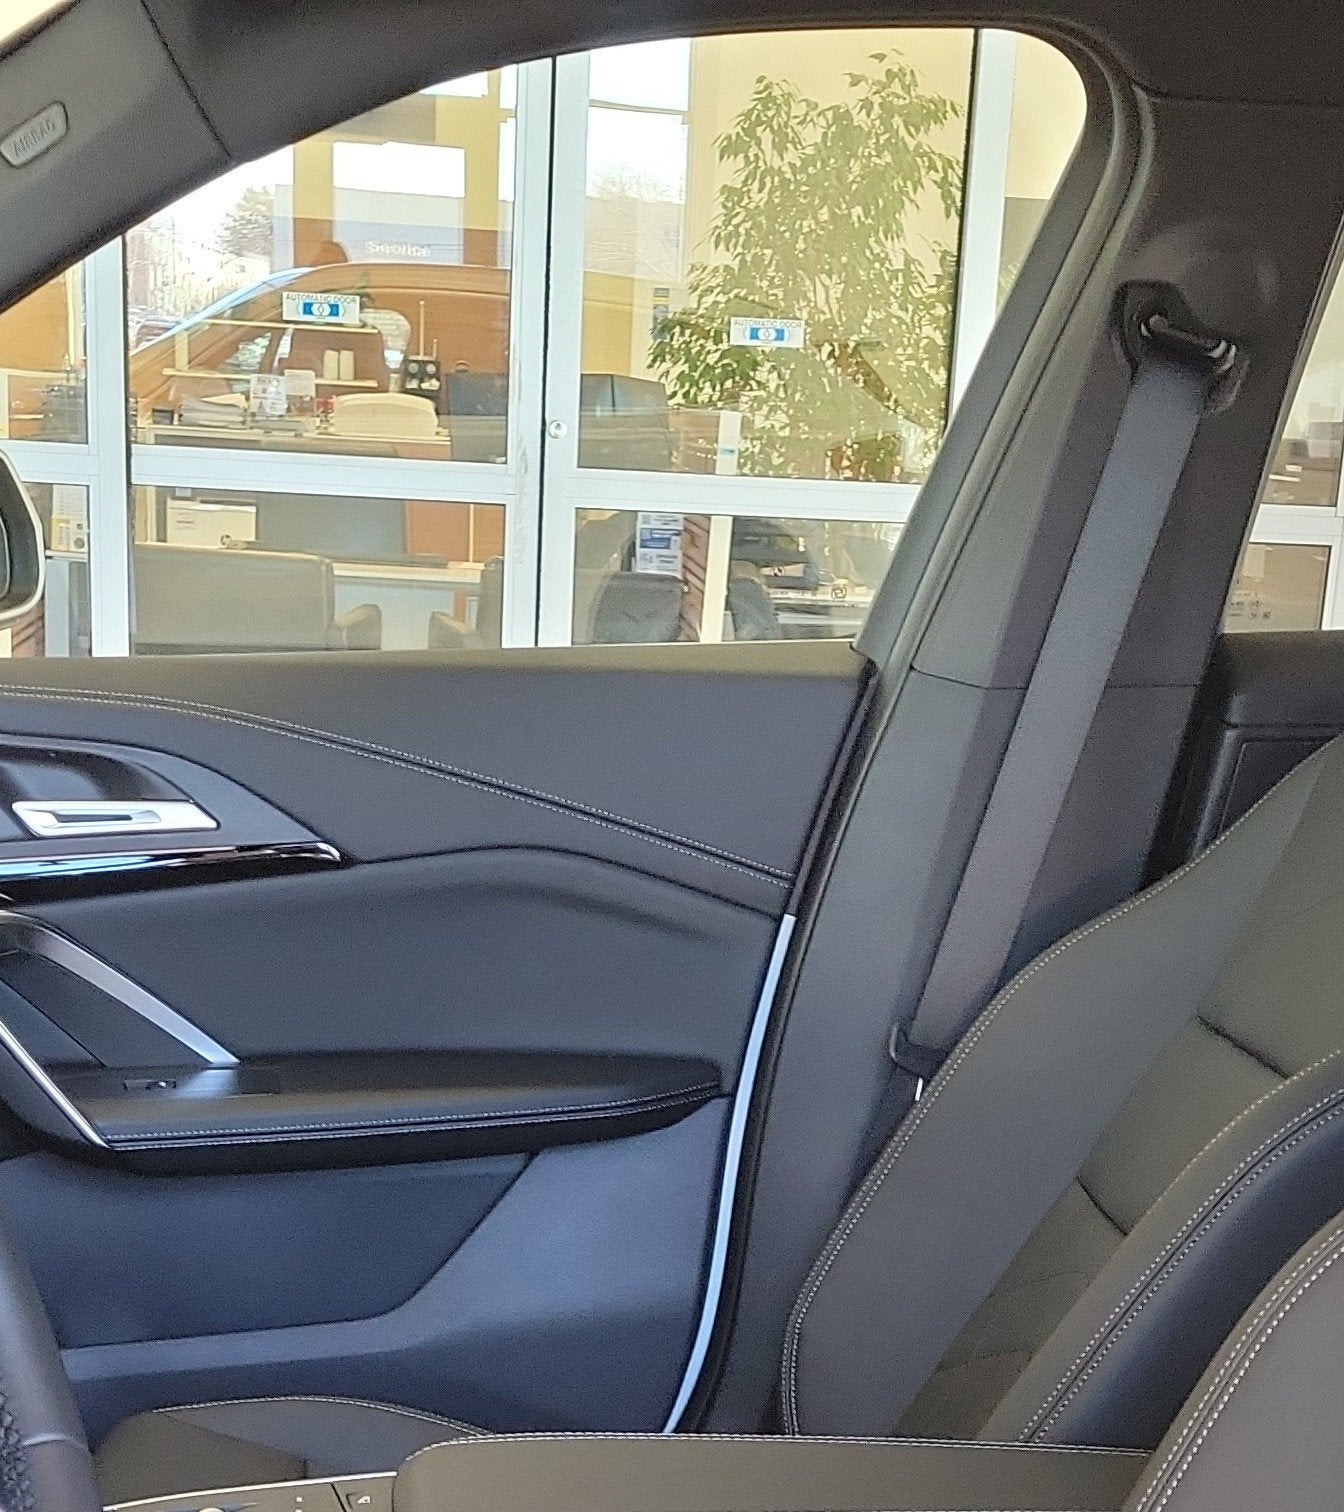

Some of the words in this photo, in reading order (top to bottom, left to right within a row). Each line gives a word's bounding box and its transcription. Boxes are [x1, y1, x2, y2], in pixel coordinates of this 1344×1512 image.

[285, 293, 331, 303] AUTOMATIC
[333, 296, 357, 305] DOOR
[733, 319, 778, 327] AUTOMATIC
[779, 321, 802, 329] DOOR
